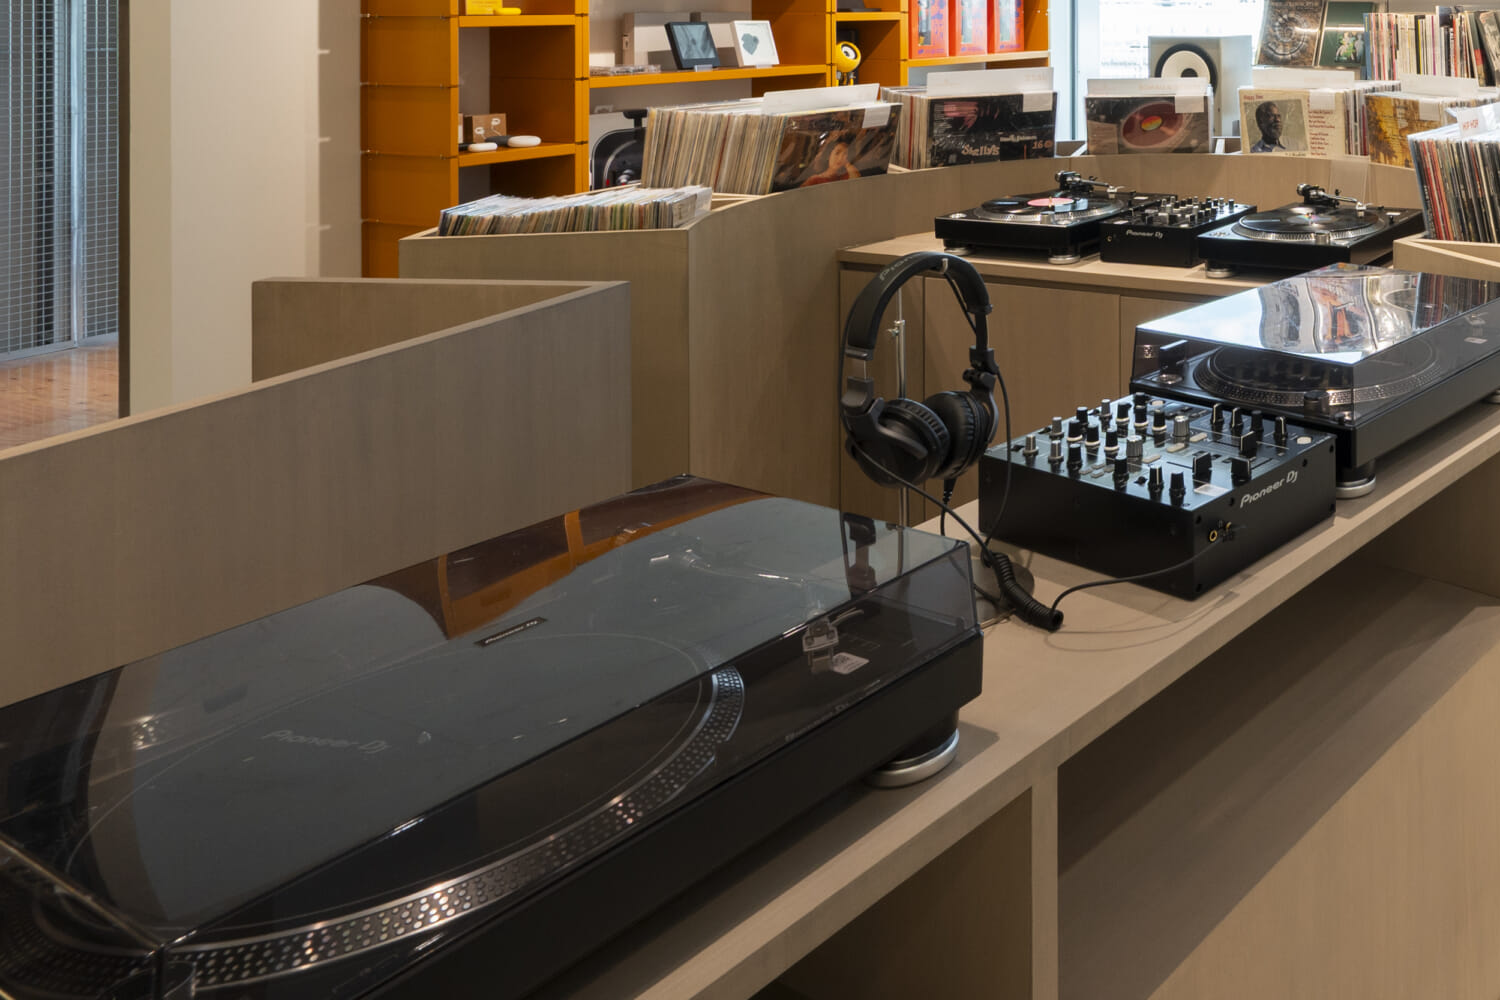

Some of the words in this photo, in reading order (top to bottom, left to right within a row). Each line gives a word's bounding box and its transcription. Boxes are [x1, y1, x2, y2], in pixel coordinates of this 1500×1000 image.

[1126, 229, 1154, 237] Pioneer
[1240, 478, 1285, 508] Pioneer
[260, 729, 359, 748] Pioneer
